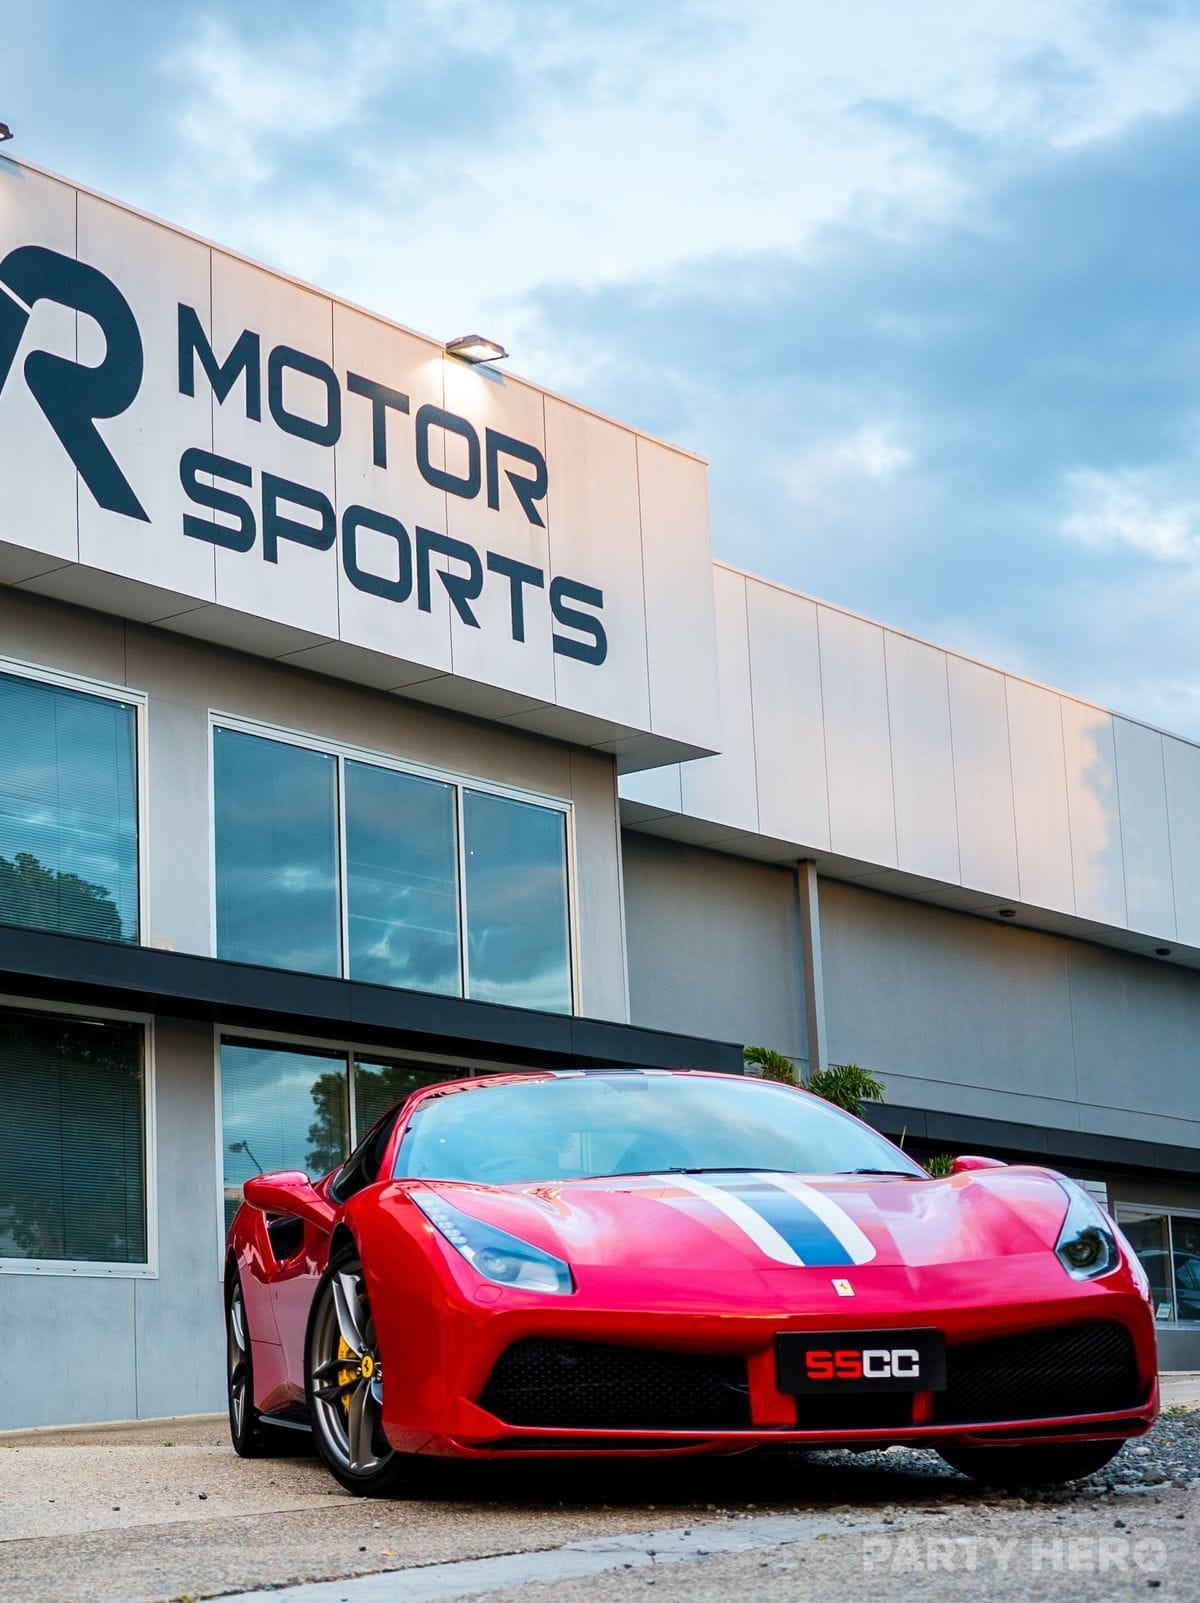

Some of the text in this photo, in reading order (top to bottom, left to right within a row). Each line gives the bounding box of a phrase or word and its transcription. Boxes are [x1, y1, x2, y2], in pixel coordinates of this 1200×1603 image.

[178, 302, 548, 528] MOTOR
[180, 447, 607, 666] SPORTS
[805, 1349, 920, 1380] SSCC
